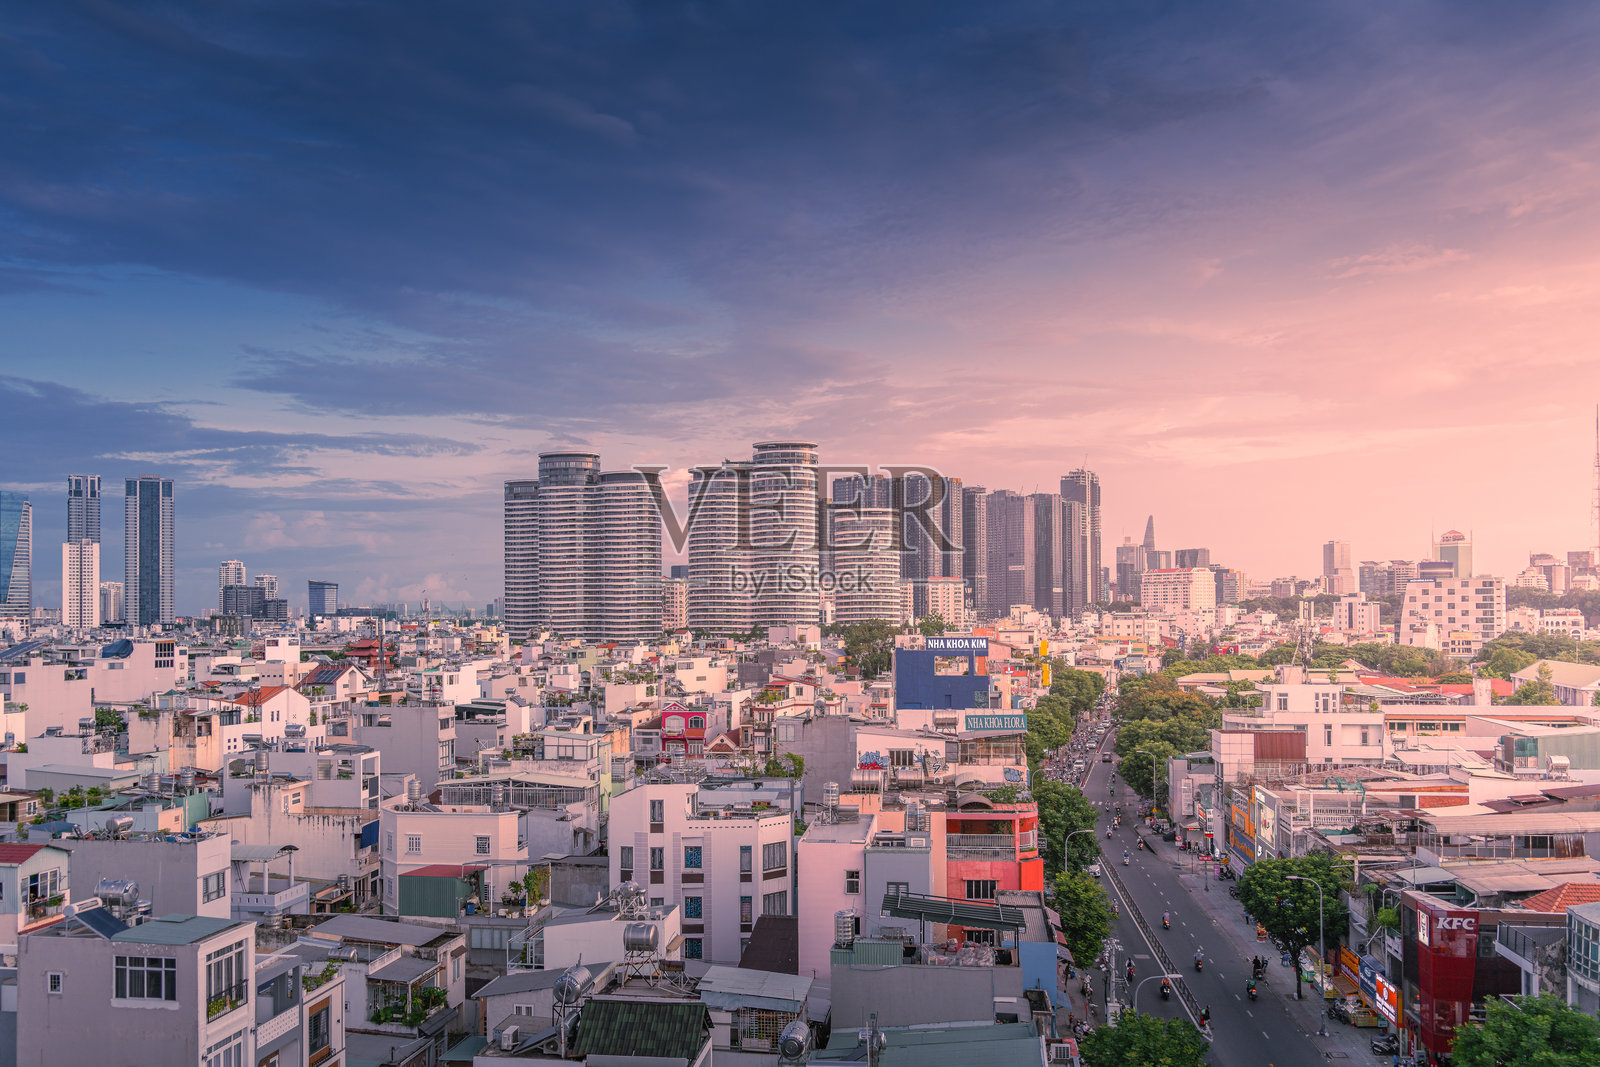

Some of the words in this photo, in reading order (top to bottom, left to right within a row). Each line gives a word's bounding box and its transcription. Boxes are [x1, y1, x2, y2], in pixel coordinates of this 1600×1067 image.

[928, 639, 945, 649] NHA
[946, 639, 970, 649] KHOA
[971, 639, 986, 649] KIM
[967, 717, 984, 729] NHA
[984, 717, 1003, 729] KHOA
[1004, 717, 1025, 729] FLORA
[1437, 917, 1476, 931] KFC
